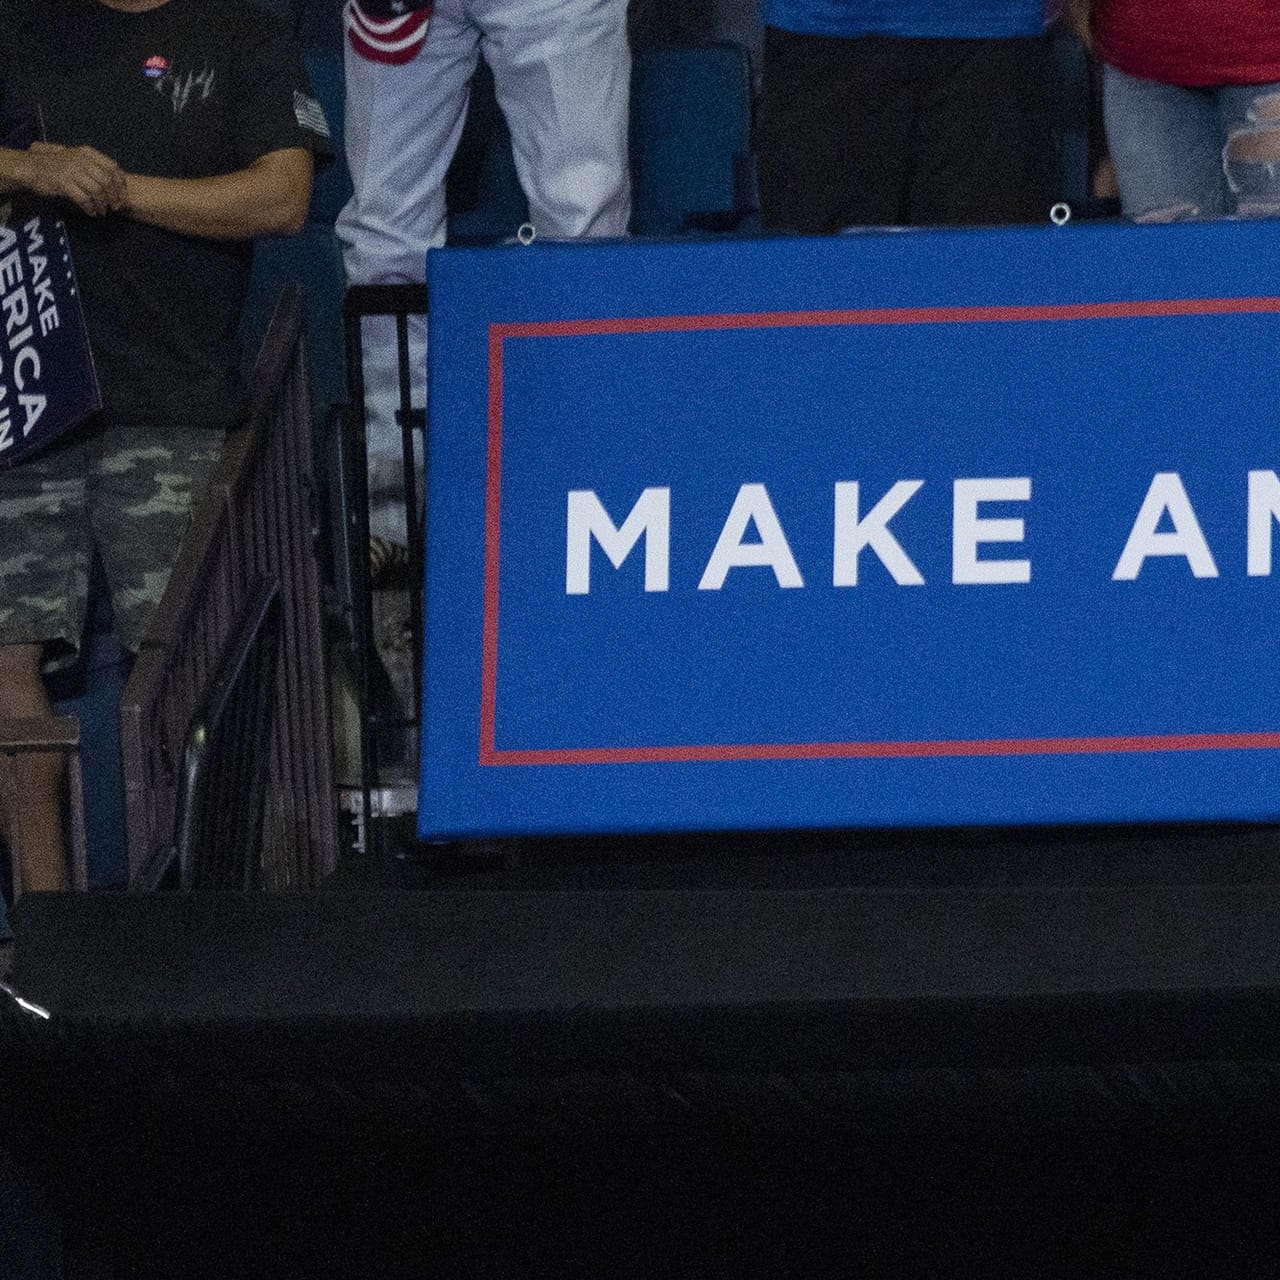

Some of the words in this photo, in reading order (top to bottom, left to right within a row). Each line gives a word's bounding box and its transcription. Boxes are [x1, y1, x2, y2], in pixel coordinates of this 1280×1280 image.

[0, 226, 47, 437] ERICA
[24, 216, 60, 337] MAKE
[566, 477, 1032, 596] MAKE
